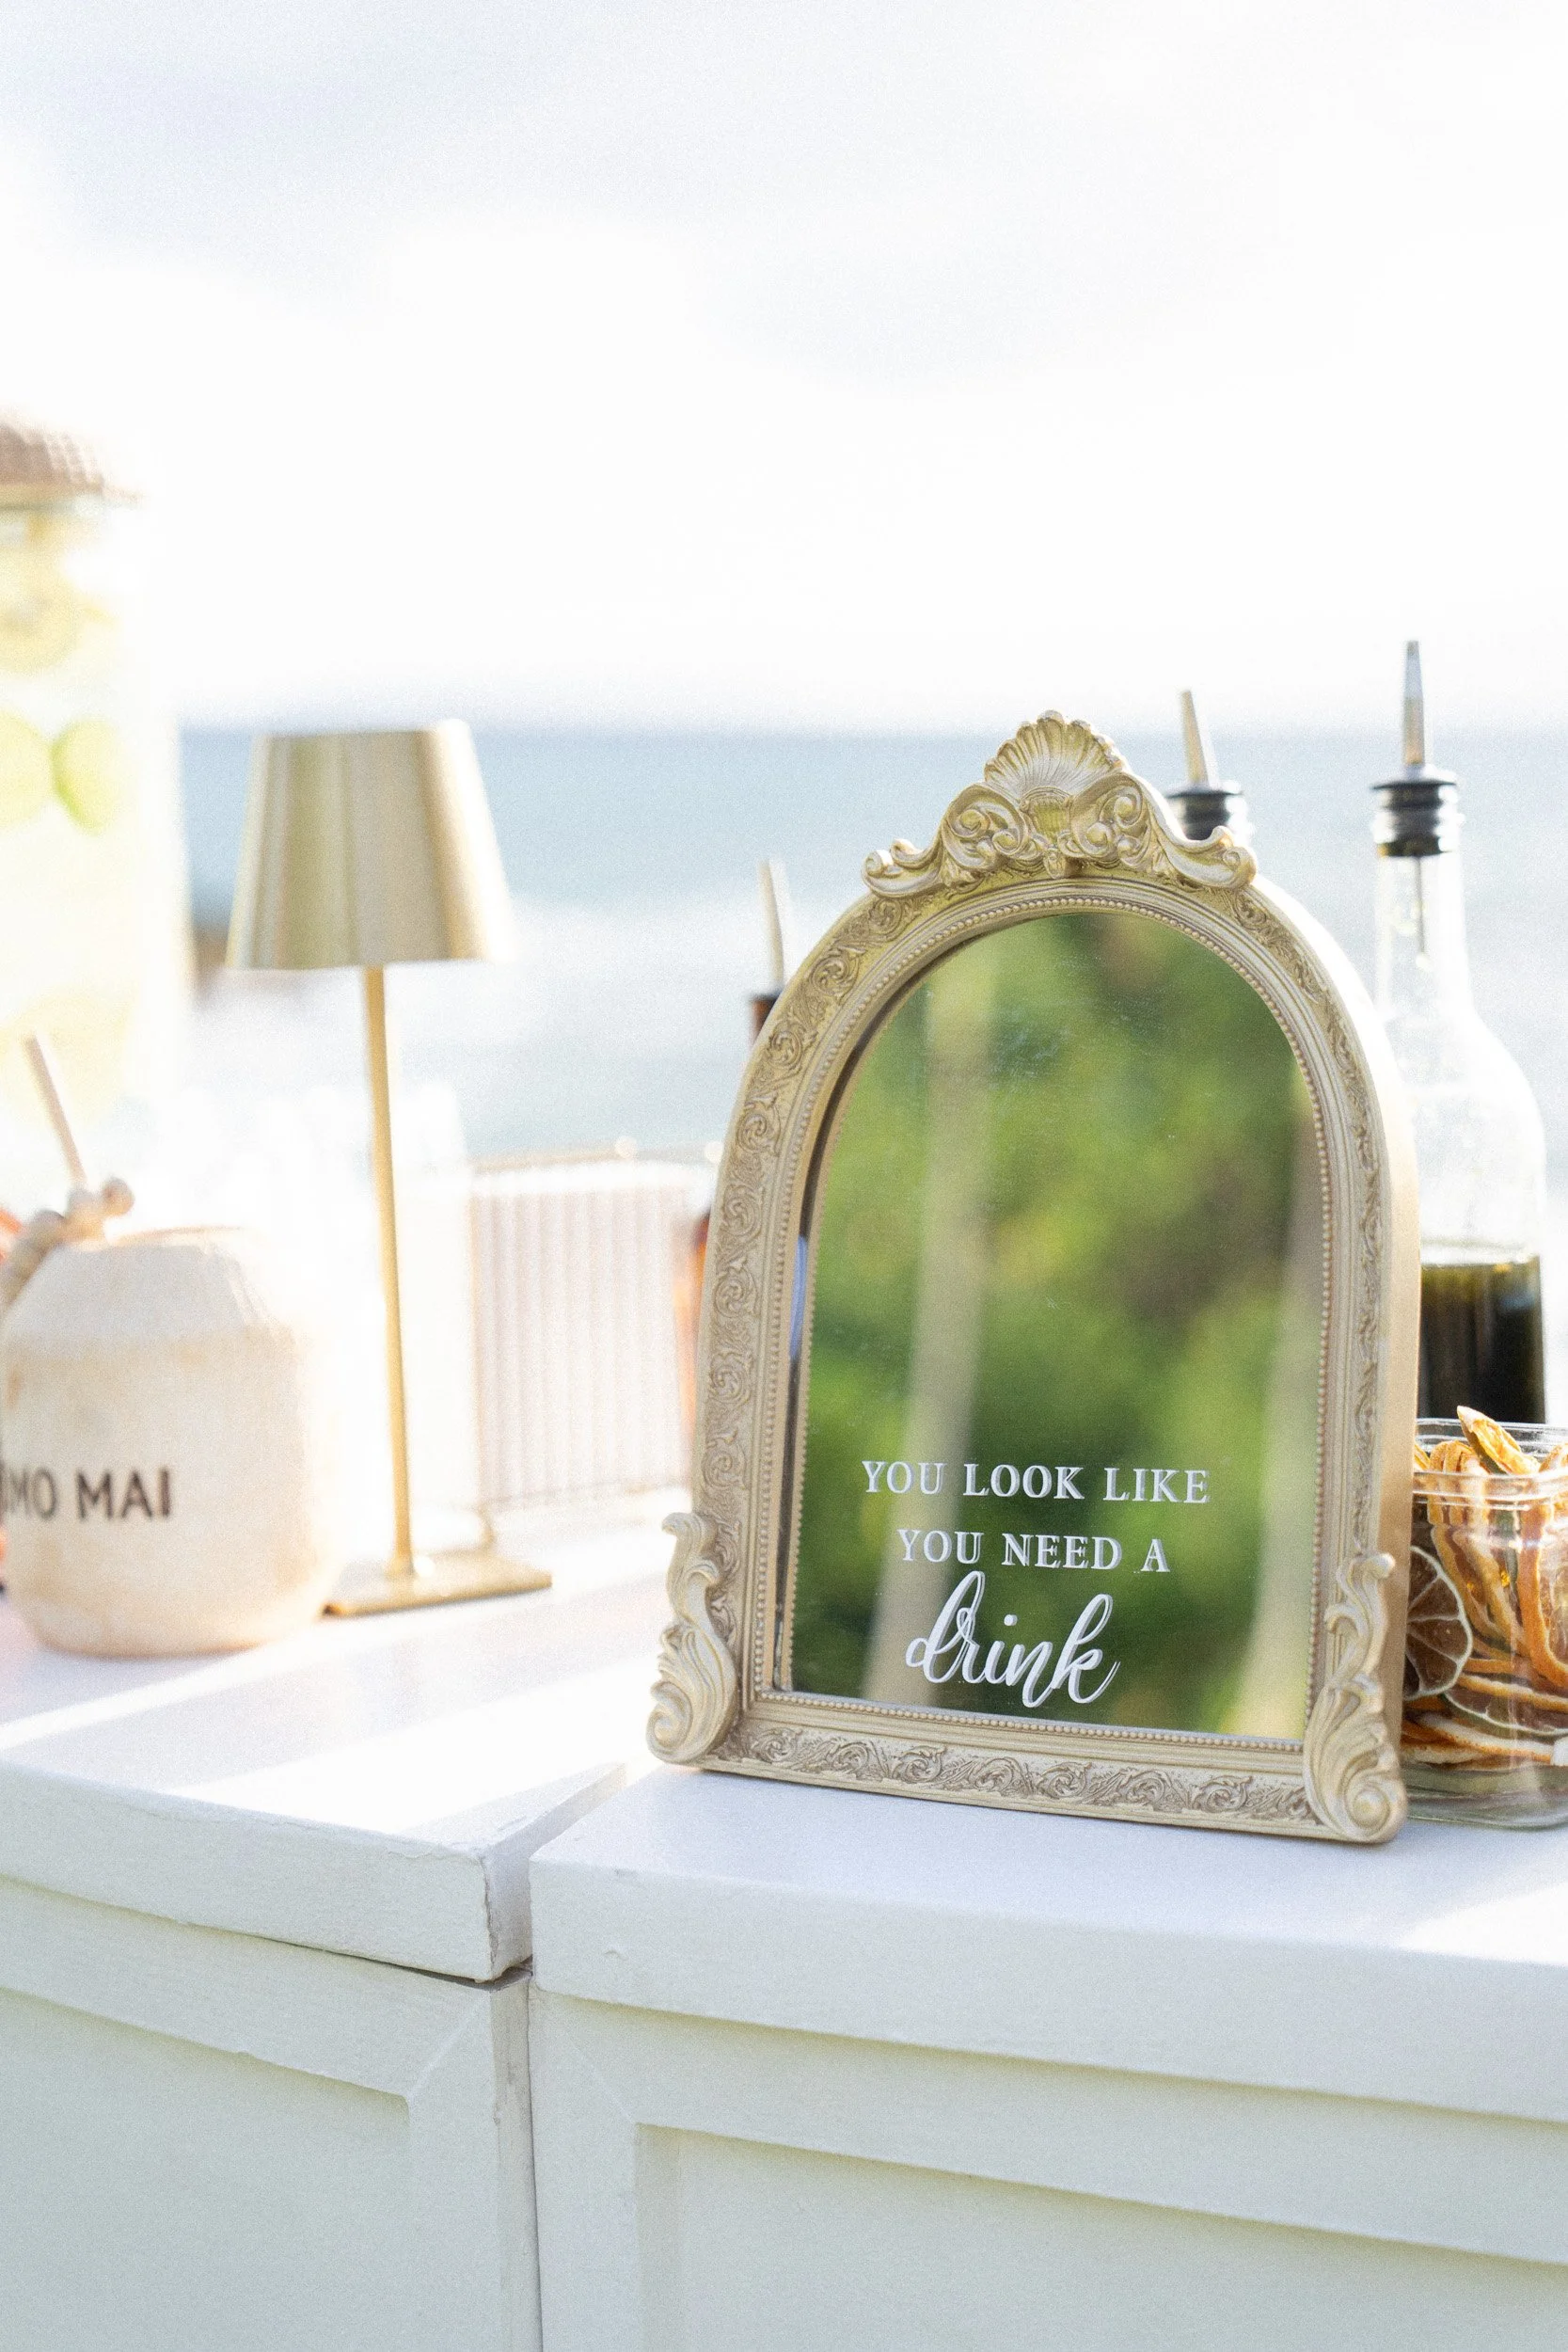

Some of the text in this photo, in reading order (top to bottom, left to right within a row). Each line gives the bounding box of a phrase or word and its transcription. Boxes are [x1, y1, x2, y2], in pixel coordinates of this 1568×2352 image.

[75, 1466, 171, 1520] MAI
[862, 1461, 1211, 1503] YOU LOOK LIKE
[897, 1529, 1170, 1572] YOU NEED A
[905, 1570, 1120, 1708] drink
